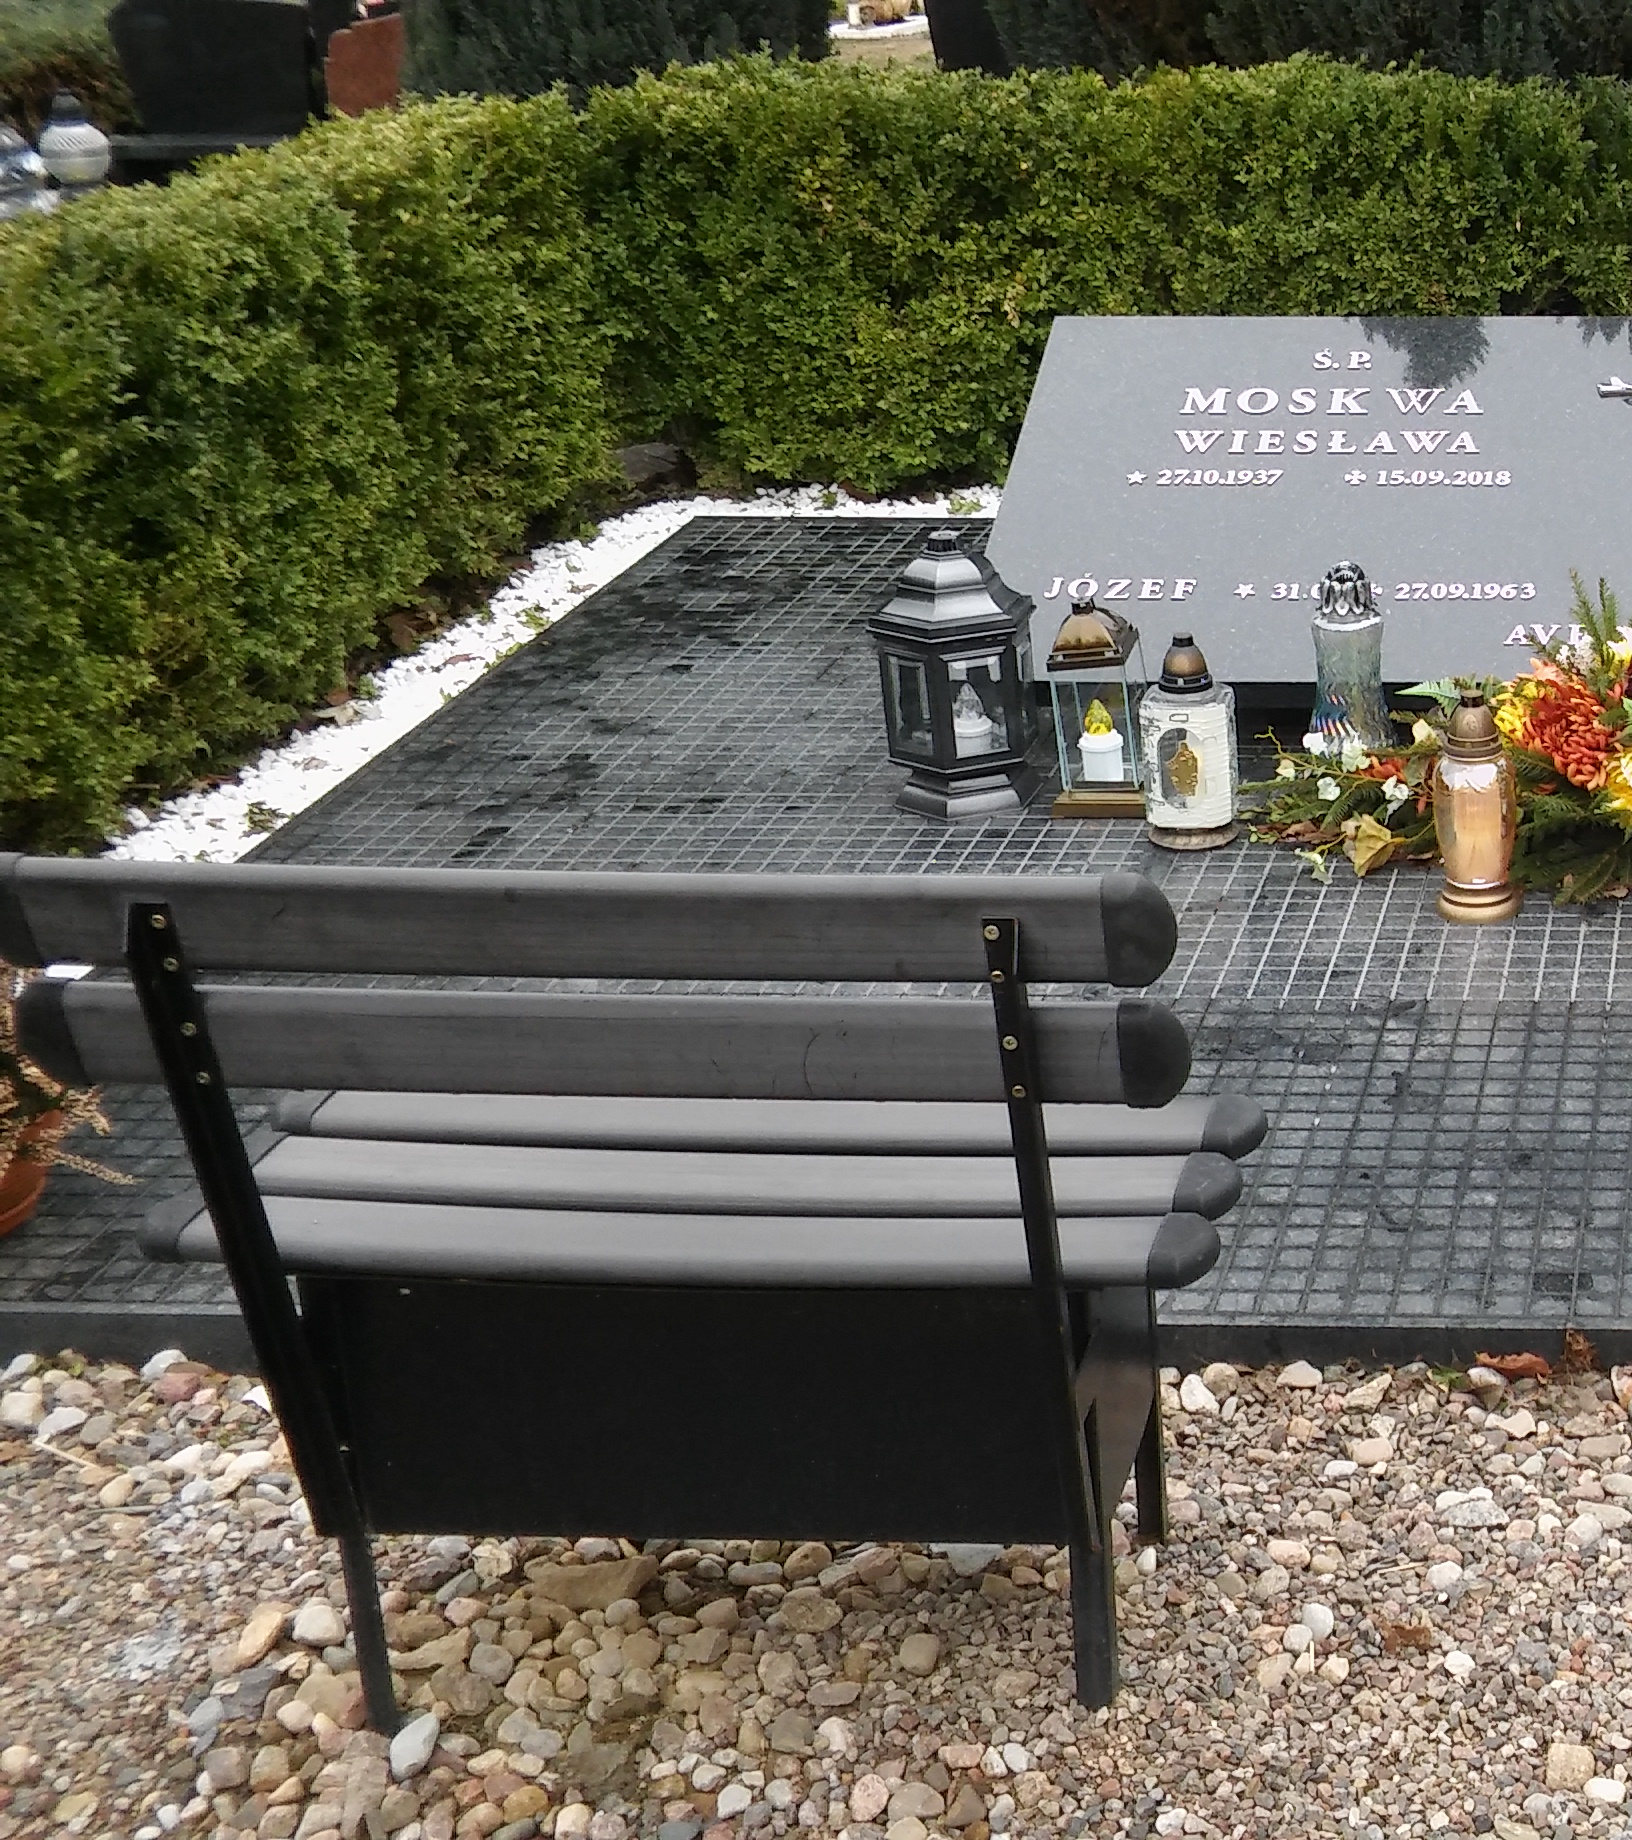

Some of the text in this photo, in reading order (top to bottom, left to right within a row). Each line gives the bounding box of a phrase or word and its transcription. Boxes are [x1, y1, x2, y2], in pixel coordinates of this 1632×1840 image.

[1179, 387, 1484, 414] MOSKWA
[1174, 430, 1480, 453] WIESŁAWA
[1156, 469, 1512, 486] 27.10.1937 15.09.2018
[1043, 572, 1198, 600] JÓZEF
[1394, 582, 1537, 599] 27.09.1963
